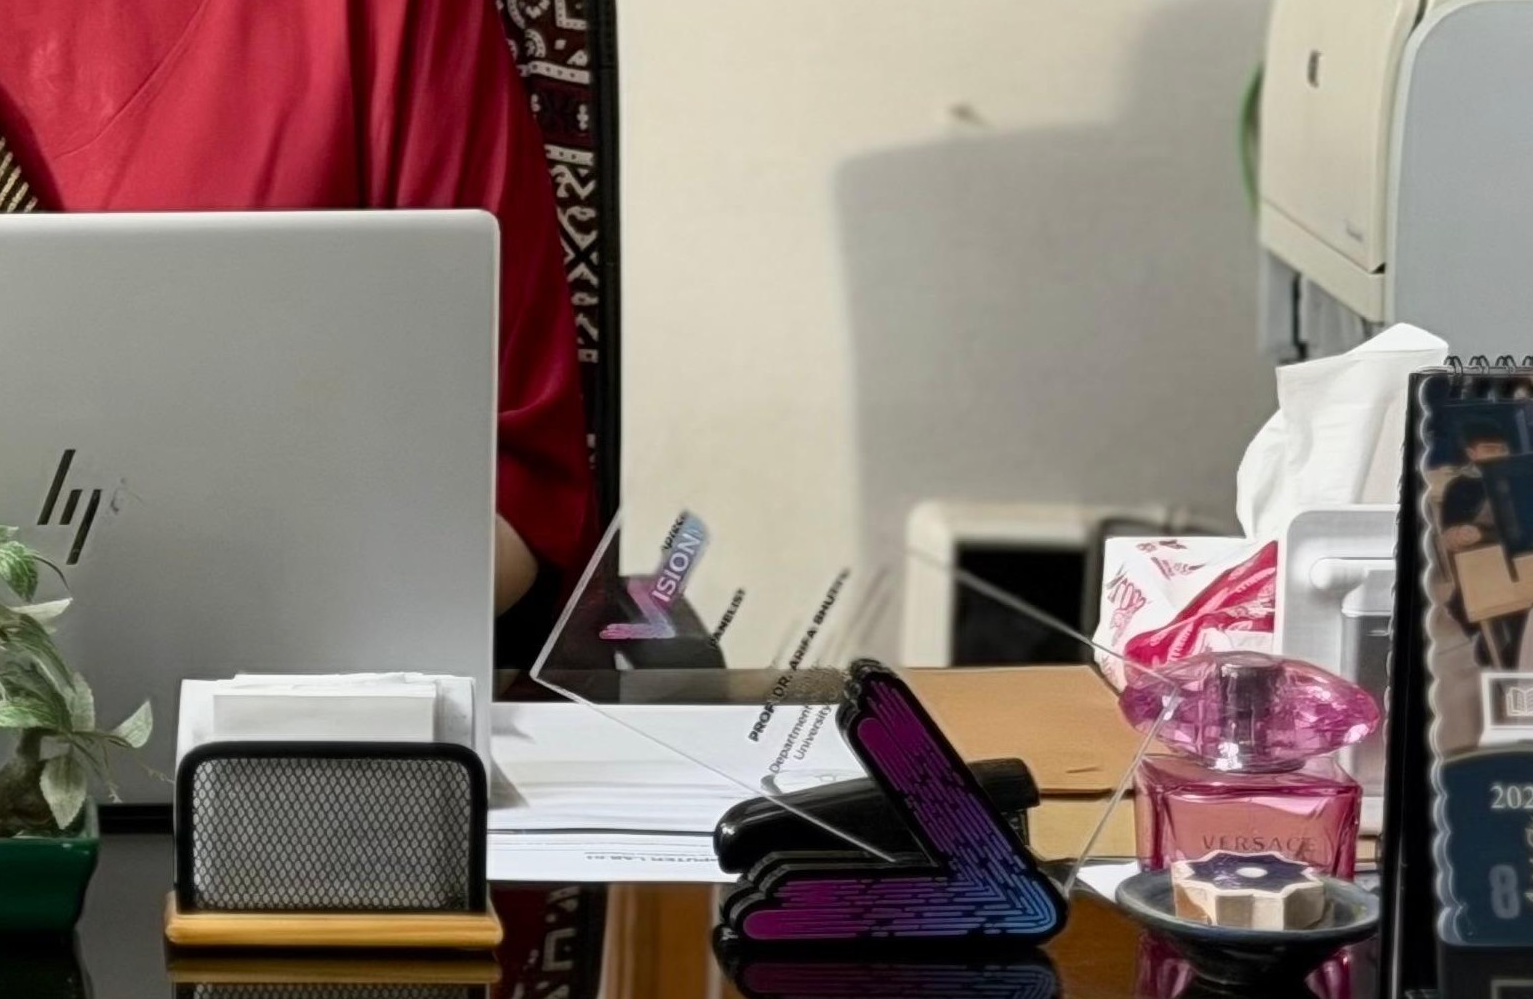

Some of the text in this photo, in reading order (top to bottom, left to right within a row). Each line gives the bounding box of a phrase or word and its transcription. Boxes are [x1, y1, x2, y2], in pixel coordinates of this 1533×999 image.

[37, 448, 102, 565] hp
[794, 703, 832, 761] University
[1203, 834, 1316, 852] VERSACE
